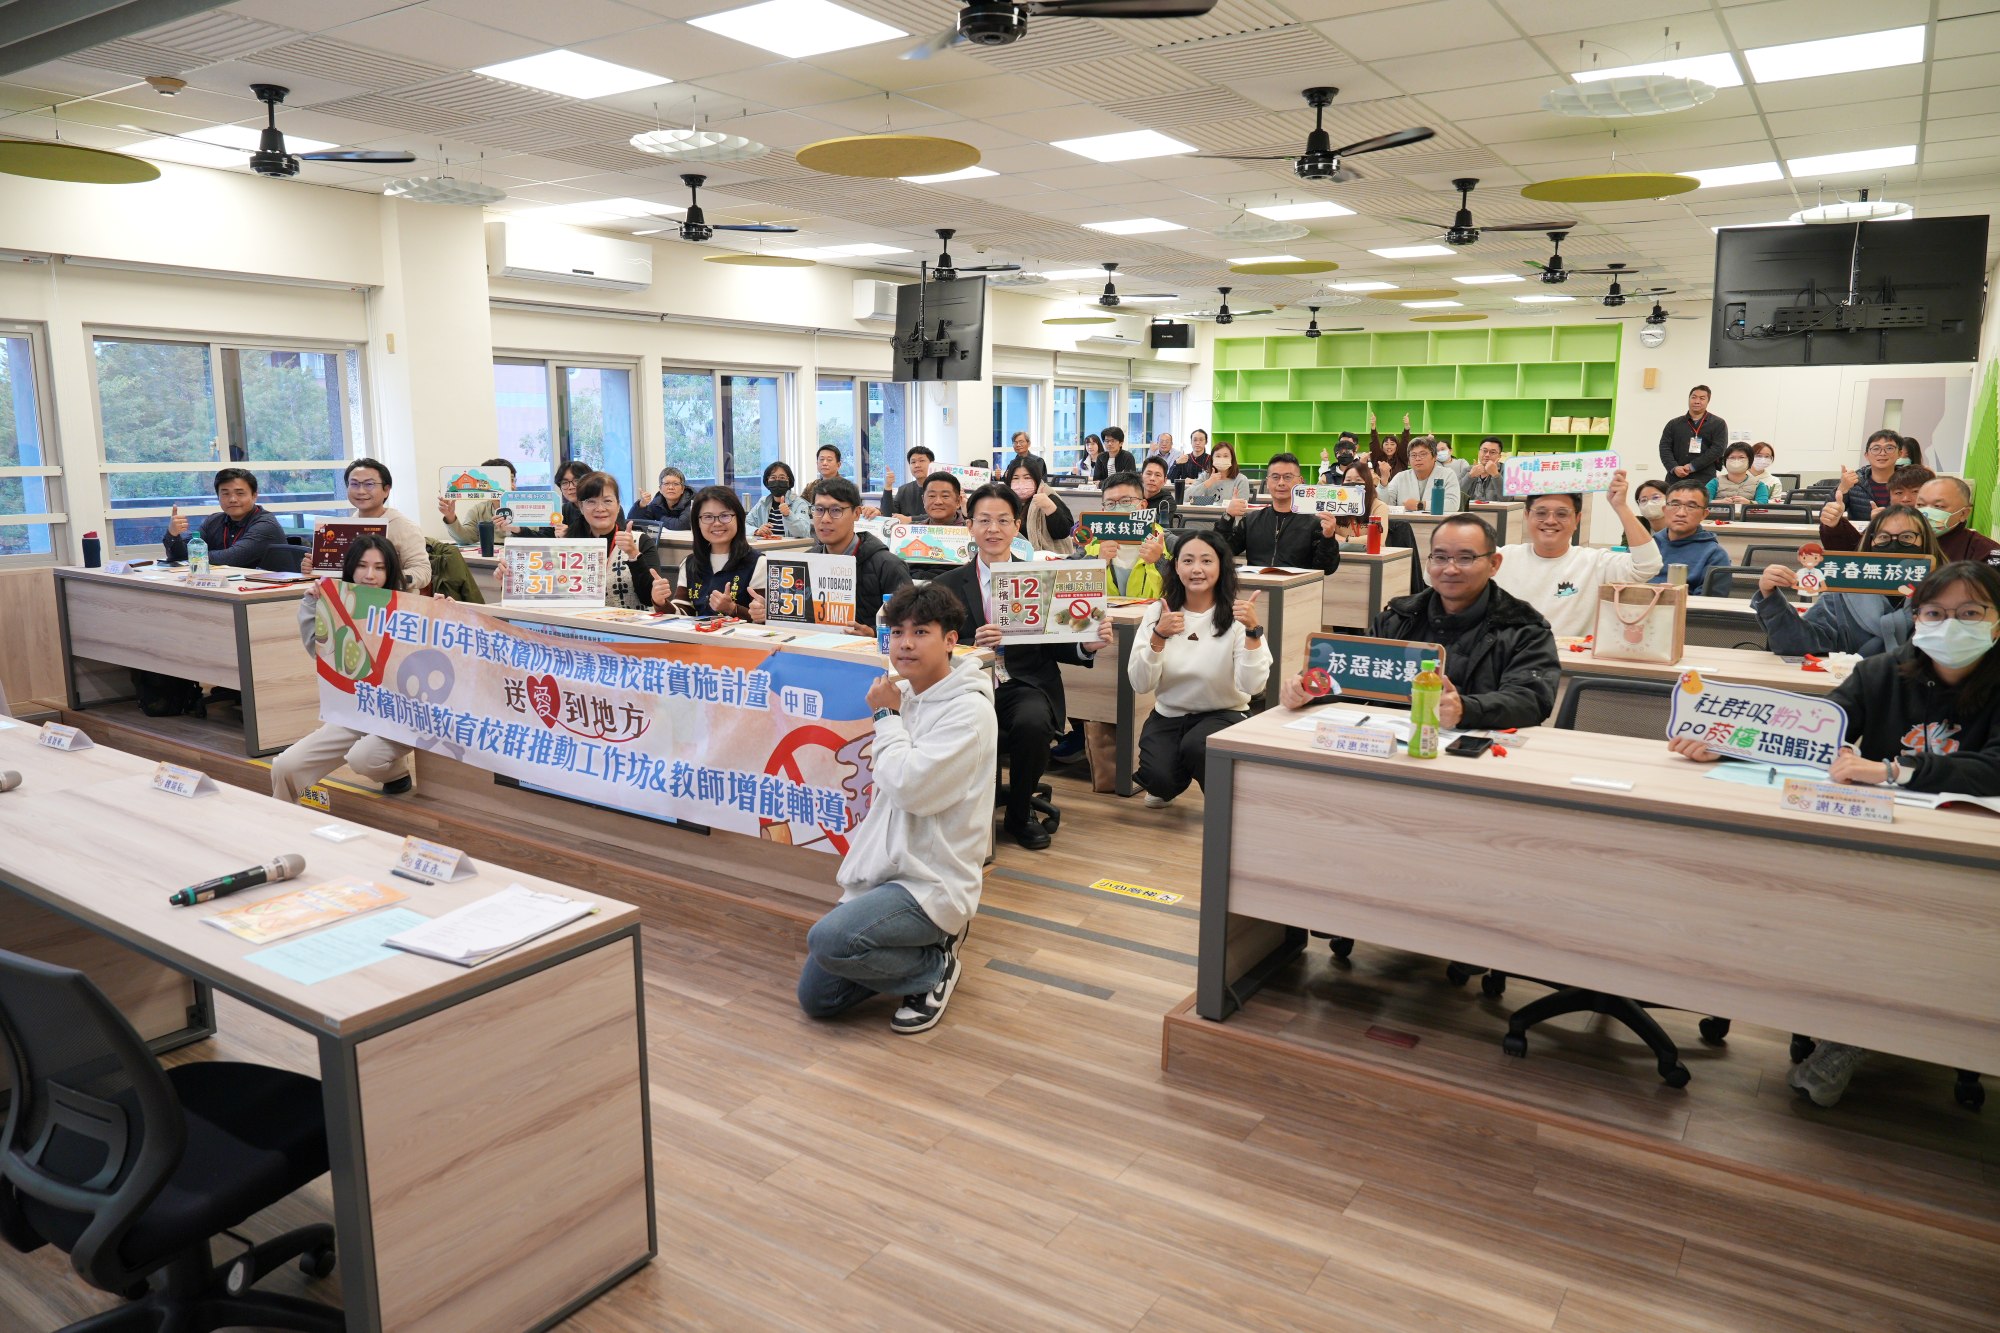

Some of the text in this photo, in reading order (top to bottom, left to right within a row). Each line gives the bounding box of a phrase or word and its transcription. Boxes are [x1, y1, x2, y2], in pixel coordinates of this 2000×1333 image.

[1131, 510, 1154, 520] PLUS
[1090, 521, 1145, 535] 檳來我擋
[528, 552, 543, 570] 5
[558, 552, 584, 570] 12
[831, 566, 853, 576] WORLD
[1820, 561, 1927, 582] 青春無菸煙
[526, 575, 553, 593] 31
[568, 575, 583, 593] 3
[780, 567, 794, 588] 5
[818, 577, 852, 591] NO TOBACCO
[831, 592, 844, 601] DAY
[1010, 578, 1040, 599] 12
[780, 593, 804, 616] 31
[999, 578, 1009, 626] 拒檳有我
[831, 604, 850, 624] MAY
[1024, 604, 1040, 625] 3
[366, 607, 770, 710] 114至115年度菸檳防制議題校群實施計畫
[1327, 651, 1418, 683] 菸惡謎漫
[504, 677, 646, 739] 送愛到地方
[784, 688, 818, 718] 中區
[1693, 693, 1802, 730] 社群吸粉
[355, 682, 848, 833] 菸檳防制教育校群推動工作坊&教師增能輔導
